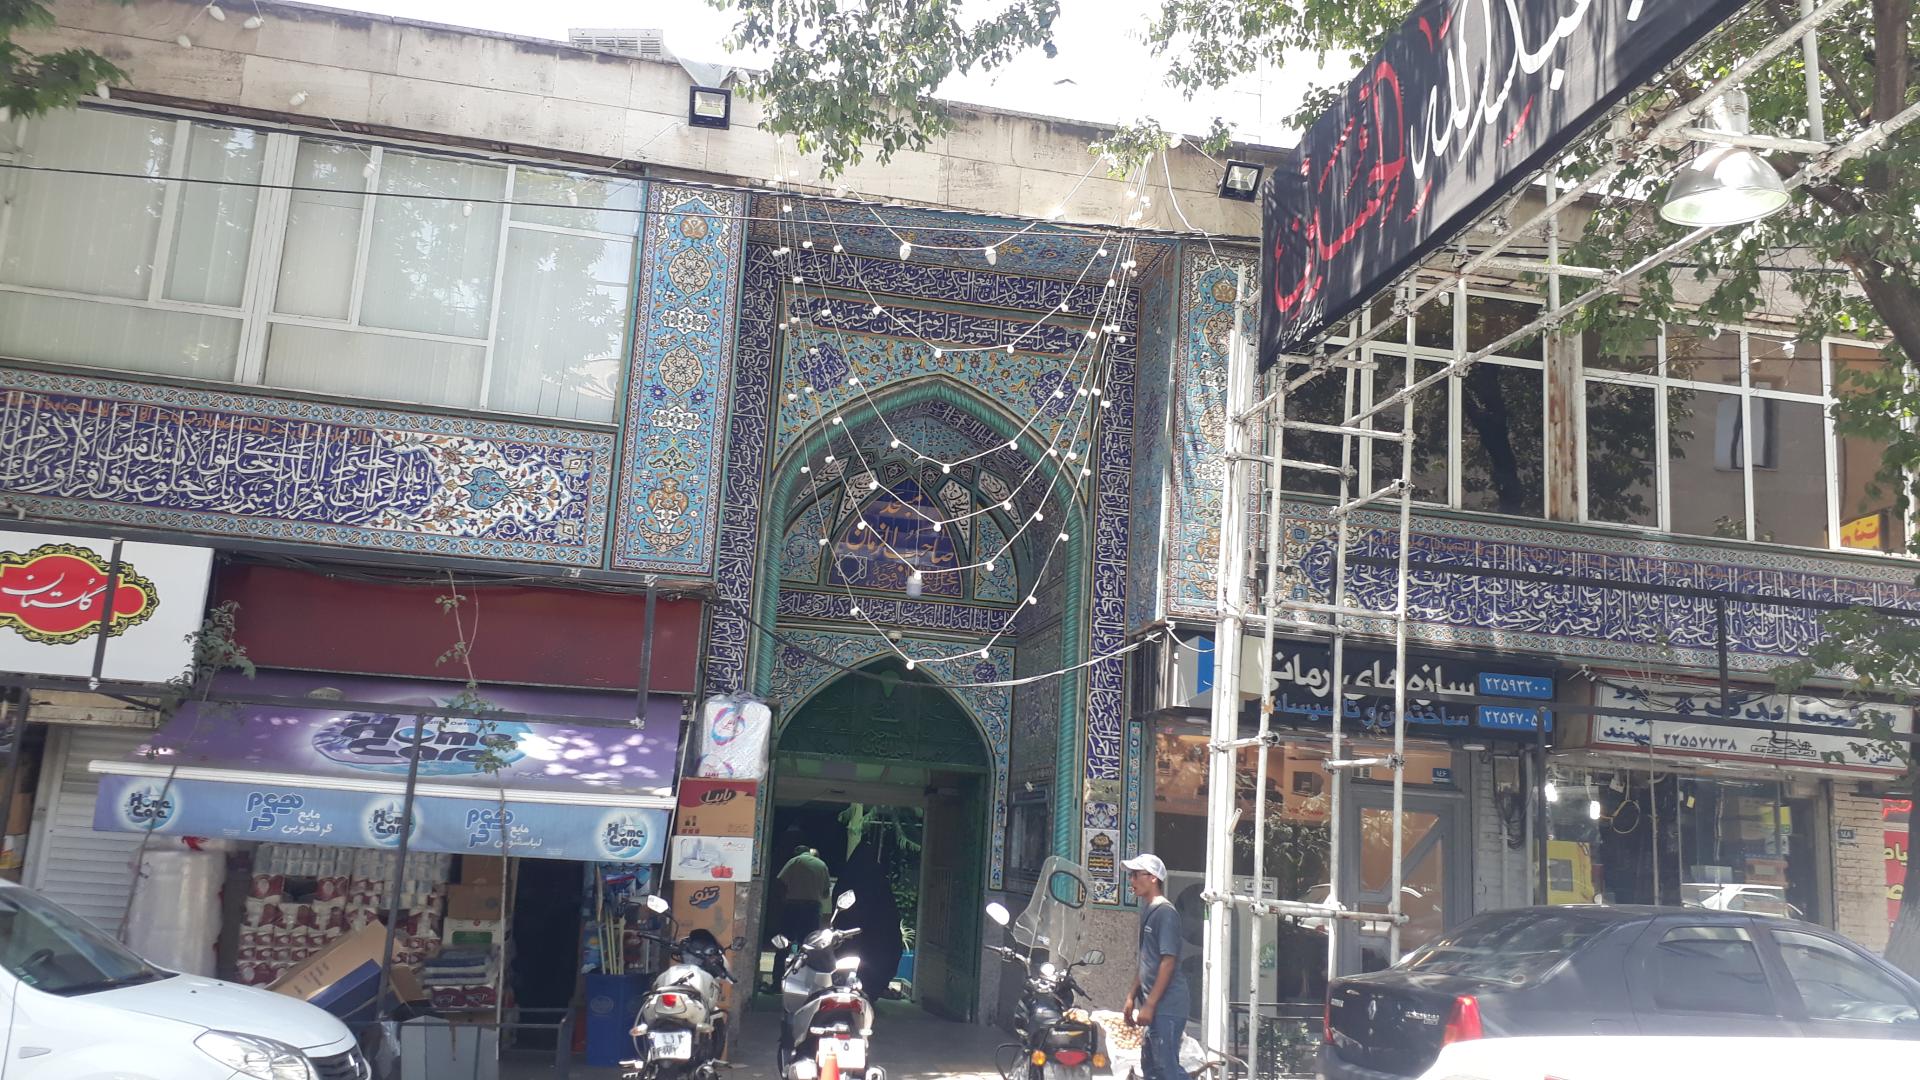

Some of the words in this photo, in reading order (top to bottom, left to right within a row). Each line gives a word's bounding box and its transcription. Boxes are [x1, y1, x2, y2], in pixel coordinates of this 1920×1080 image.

[2, 572, 108, 611] گلستان
[1484, 710, 1547, 727] ۲۲۵۴۷۰۵
[341, 716, 512, 746] Home
[1664, 733, 1737, 751] ۲۲۵۵۷۷۳۸
[298, 809, 321, 823] مایع
[607, 822, 645, 838] Home
[609, 835, 641, 848] Care
